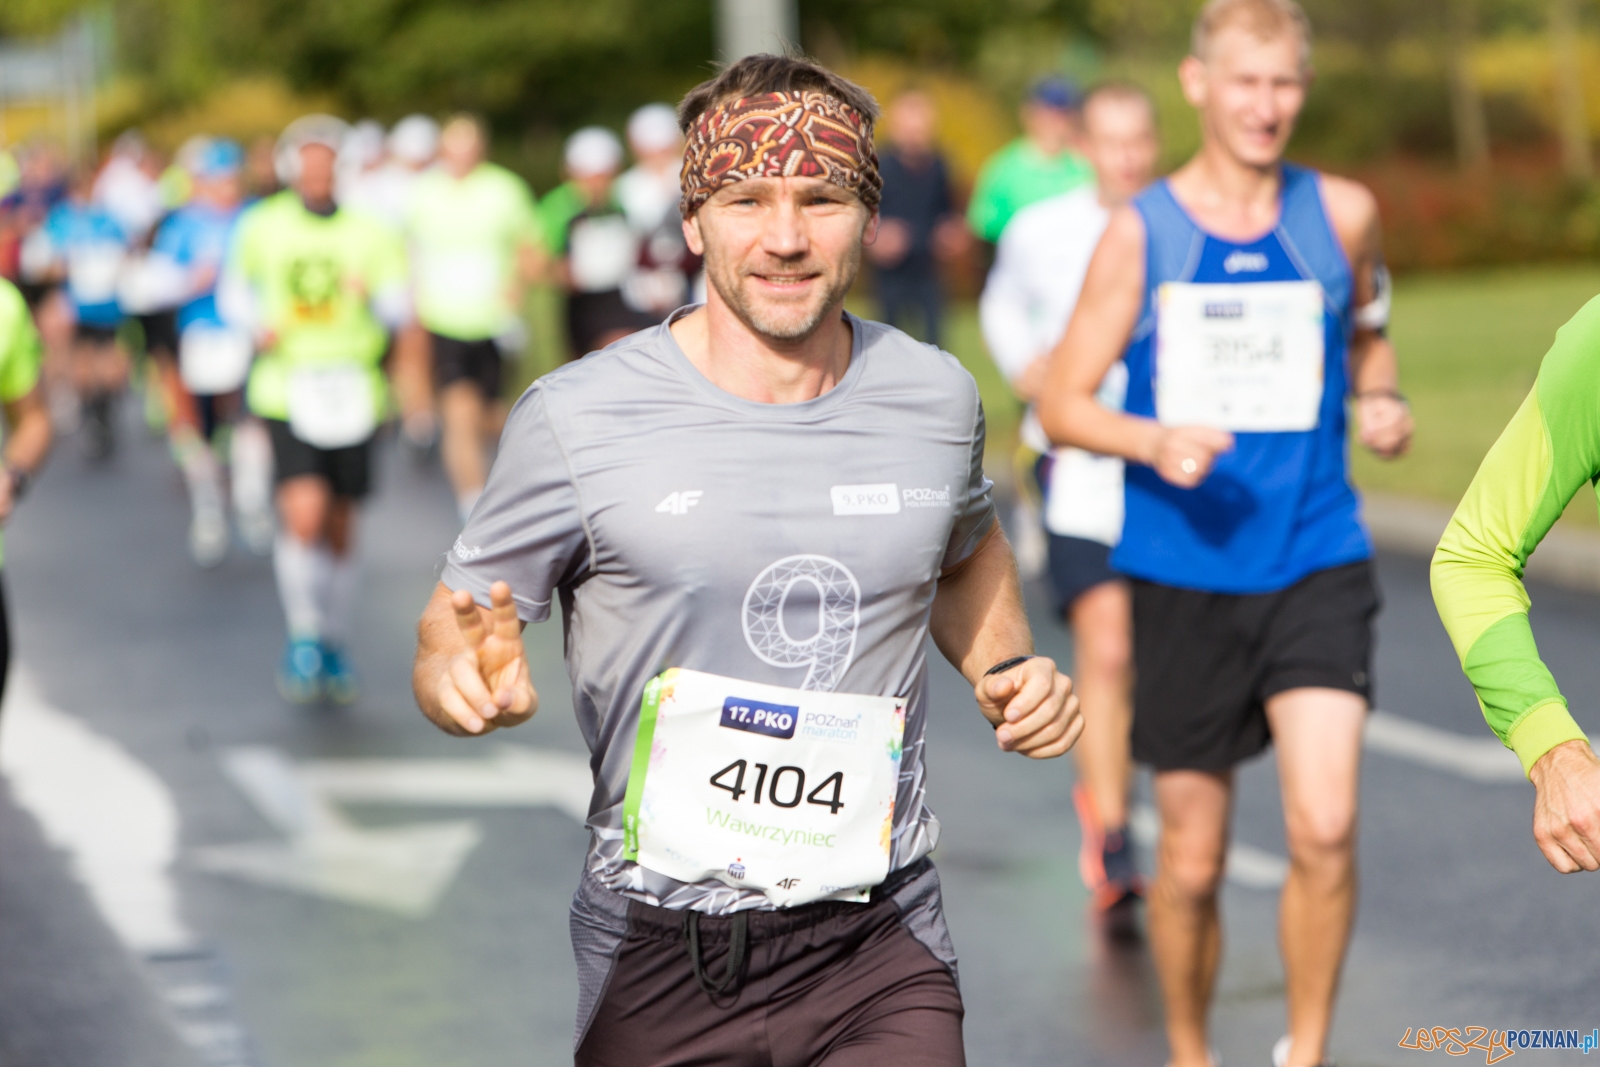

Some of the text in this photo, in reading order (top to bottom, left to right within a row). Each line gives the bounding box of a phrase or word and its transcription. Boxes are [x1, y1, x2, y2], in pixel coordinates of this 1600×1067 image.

[655, 490, 704, 515] 4F
[801, 725, 858, 740] maraton
[709, 758, 845, 815] 4104
[706, 806, 837, 848] Wawrzyniec
[776, 877, 801, 890] 4F
